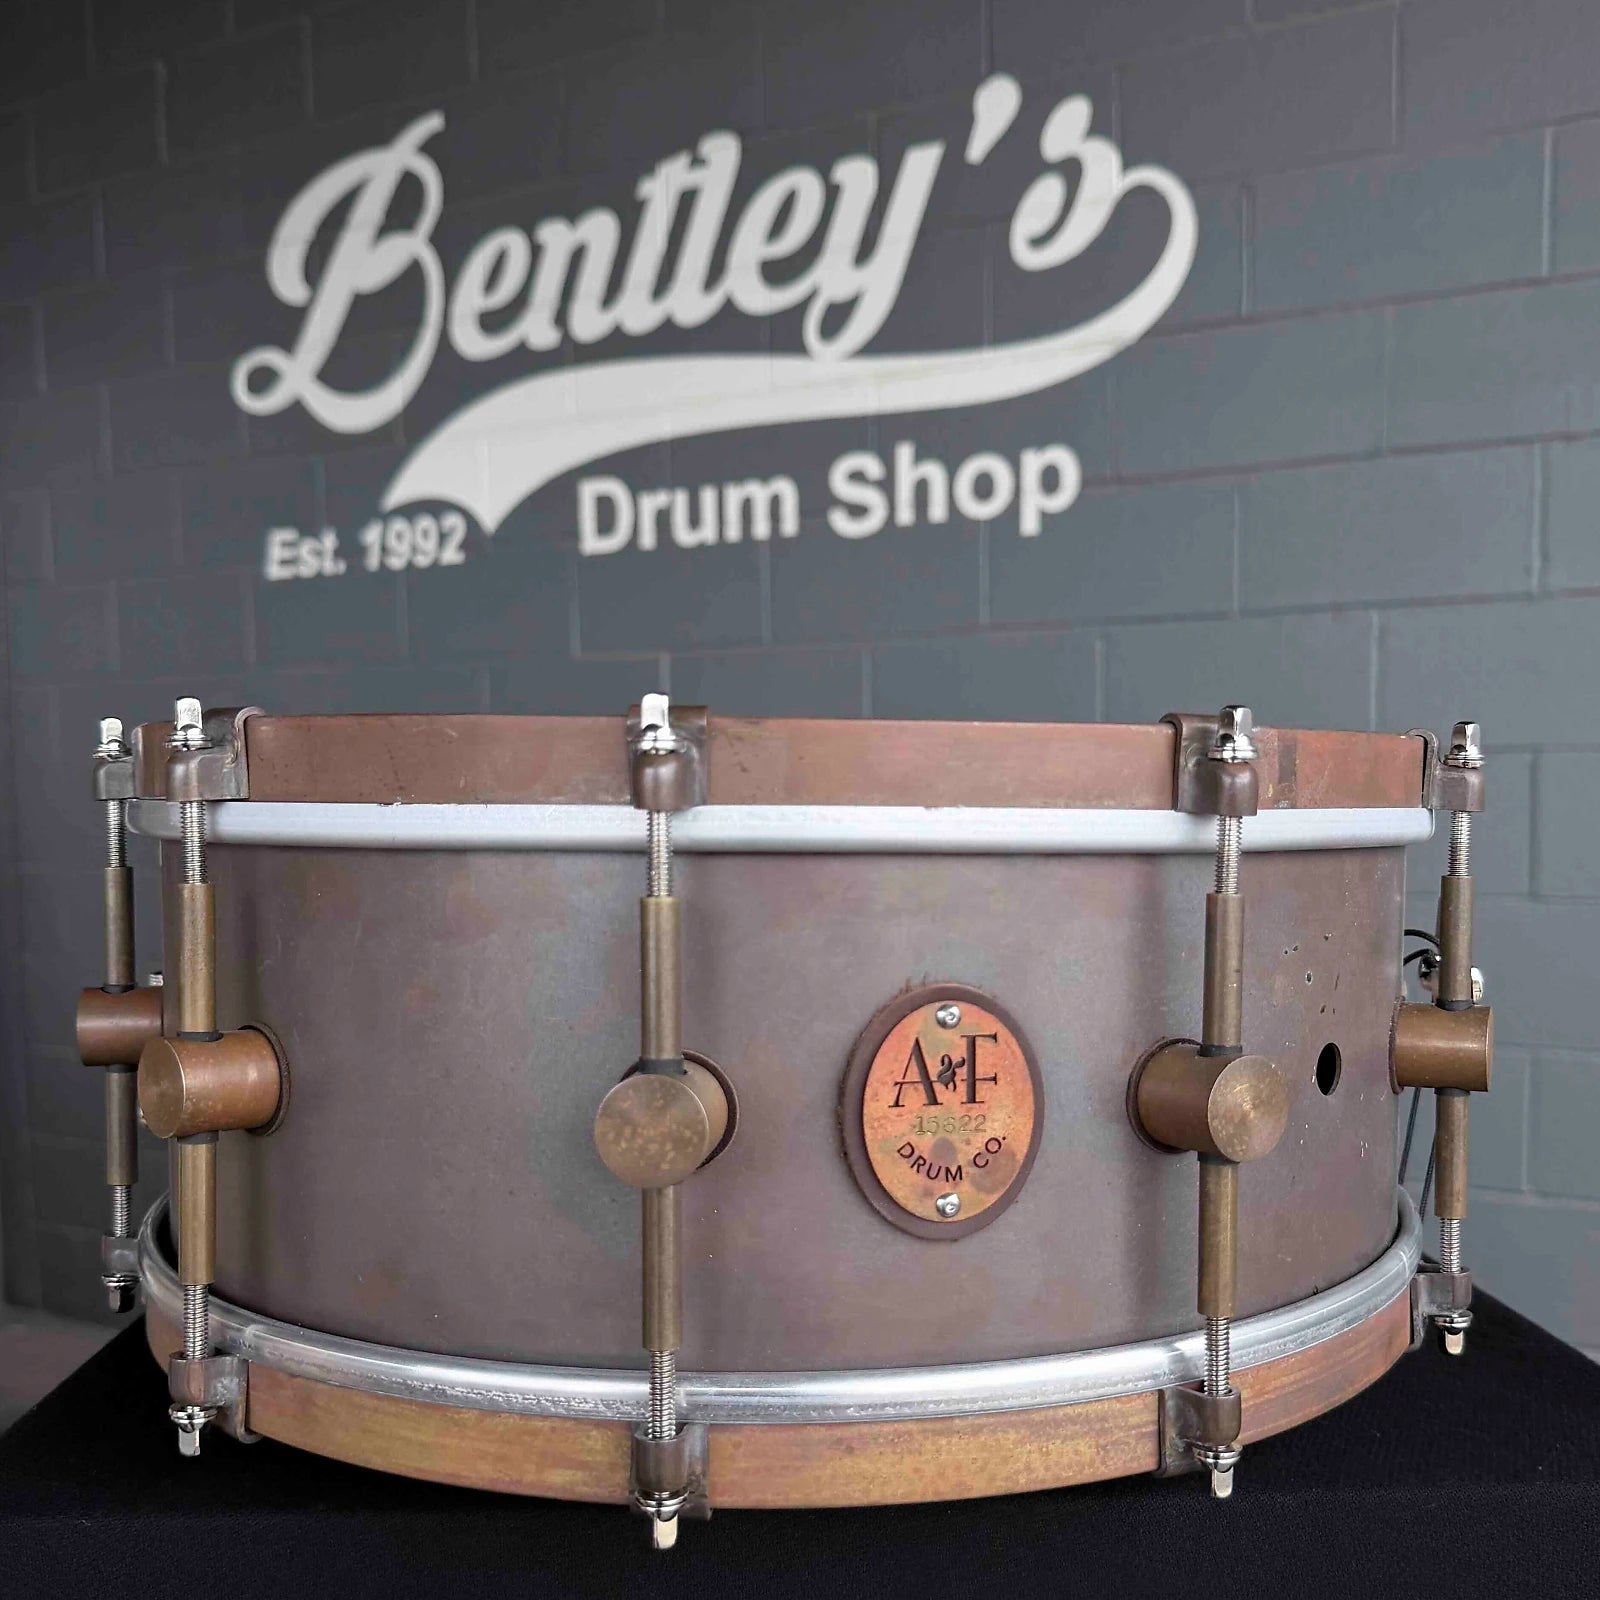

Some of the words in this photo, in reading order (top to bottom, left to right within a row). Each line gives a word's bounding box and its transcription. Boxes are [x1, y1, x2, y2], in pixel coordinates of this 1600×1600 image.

[231, 73, 1199, 435] Bentley's
[577, 474, 799, 557] Drum
[828, 442, 1082, 539] Shop
[264, 526, 347, 581] Est.
[362, 510, 467, 572] 1992
[897, 1141, 963, 1183] DRUM
[972, 1135, 1007, 1169] CO.
[914, 1114, 987, 1136] 15622
